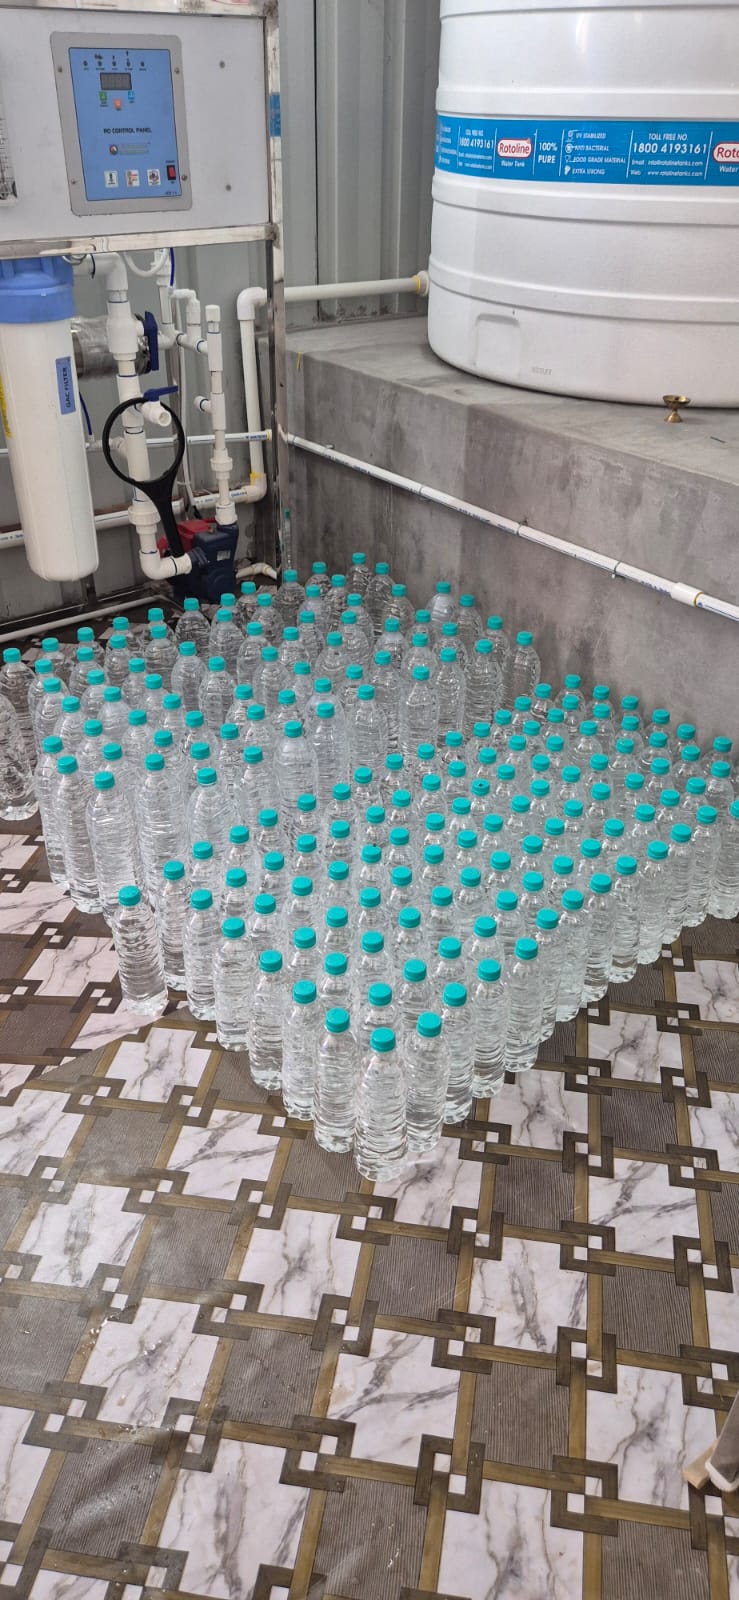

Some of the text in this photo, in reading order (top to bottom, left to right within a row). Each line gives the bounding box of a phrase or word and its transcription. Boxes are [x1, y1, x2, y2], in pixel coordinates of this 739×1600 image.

[648, 133, 662, 141] TOLL
[663, 133, 676, 141] FREE
[470, 138, 494, 149] 4193161
[500, 142, 530, 154] Rotoline
[539, 142, 558, 151] 100%
[633, 142, 707, 154] 1800 4193161
[538, 155, 556, 164] PURE
